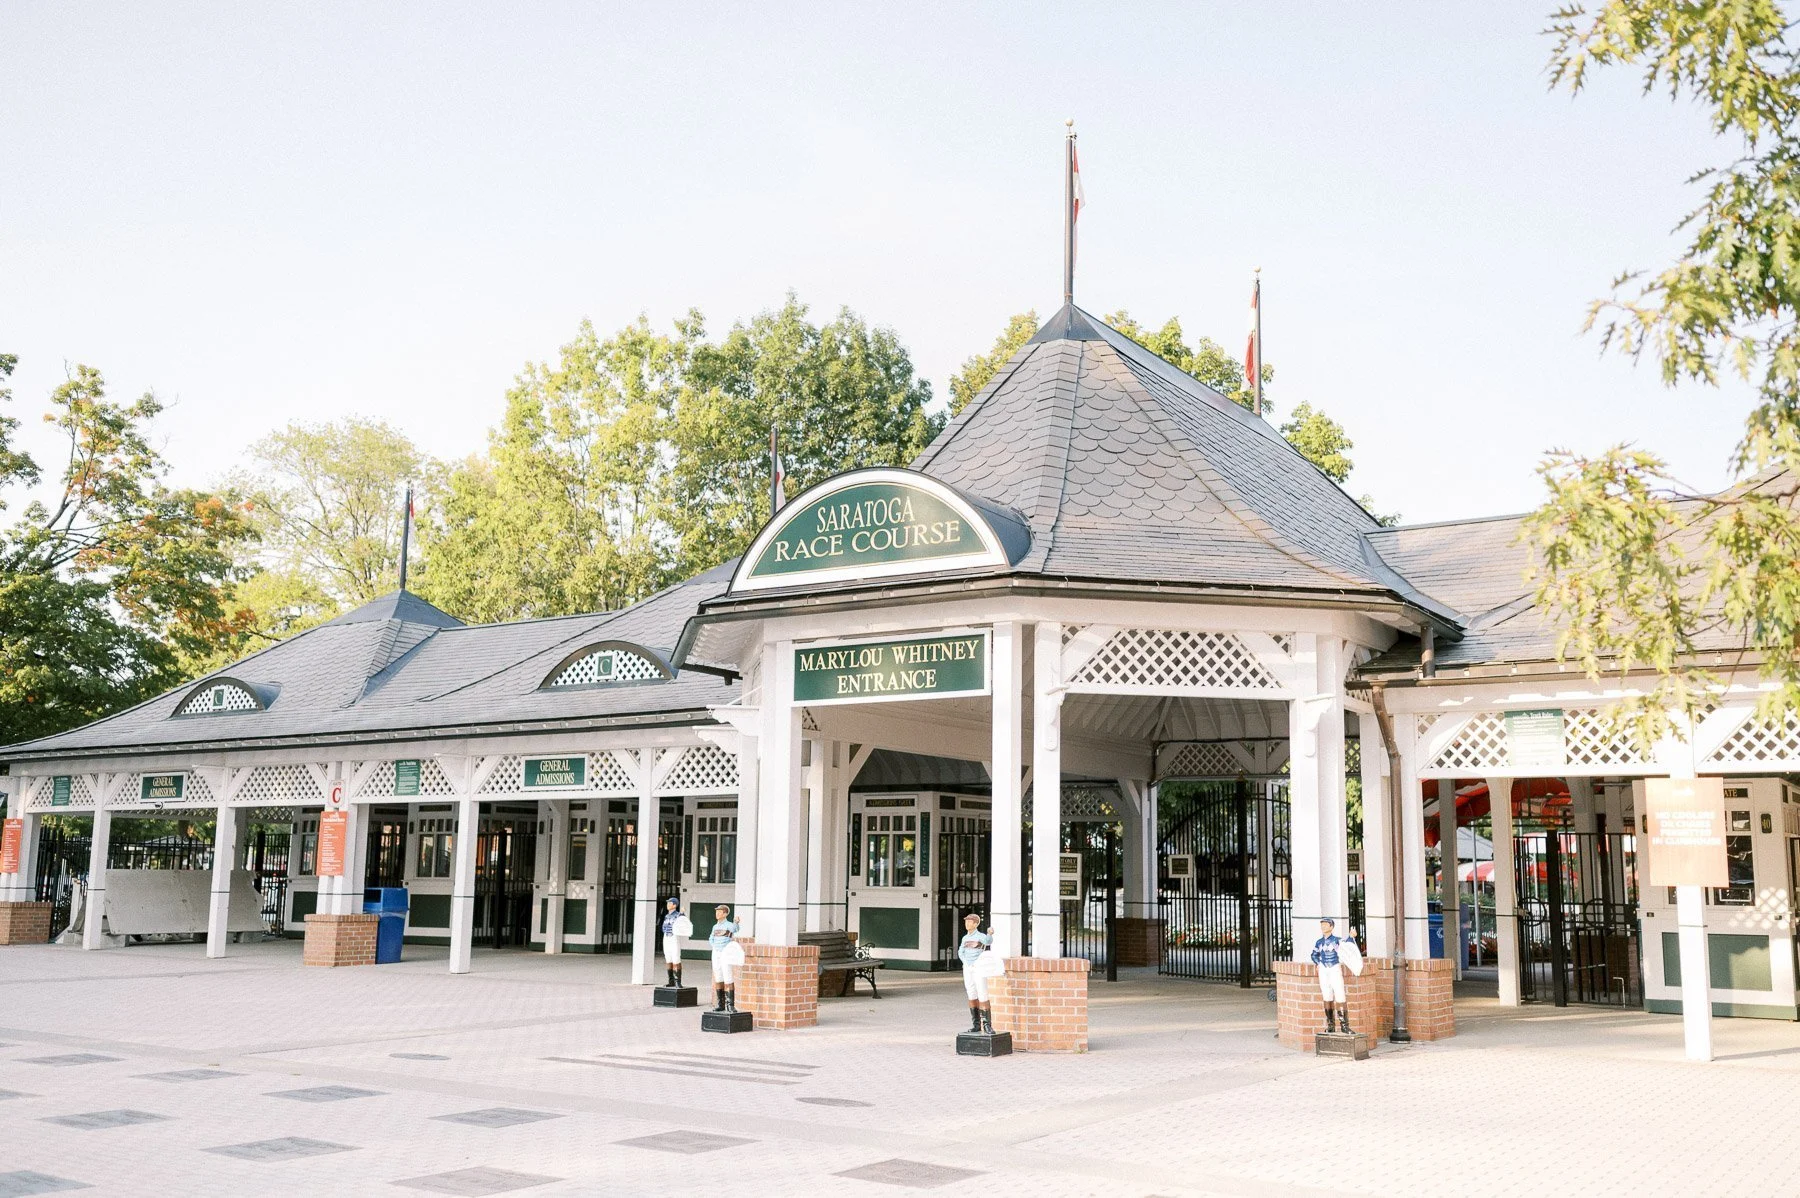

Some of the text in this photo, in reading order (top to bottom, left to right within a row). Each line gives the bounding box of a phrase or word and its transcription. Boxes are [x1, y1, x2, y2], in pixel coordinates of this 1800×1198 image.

[817, 496, 915, 534] SARATOGA
[774, 520, 961, 562] RACE COURSE
[800, 639, 979, 672] MARYLOU WHITNEY
[600, 658, 610, 674] C
[837, 669, 937, 694] ENTRANCE
[214, 691, 223, 705] C
[540, 760, 571, 772] GENERAL
[152, 776, 174, 787] GENERAL
[535, 772, 575, 785] ADMISSIONS
[148, 787, 177, 798] ADMISSIONS
[332, 787, 342, 803] C
[1724, 789, 1738, 797] ATE
